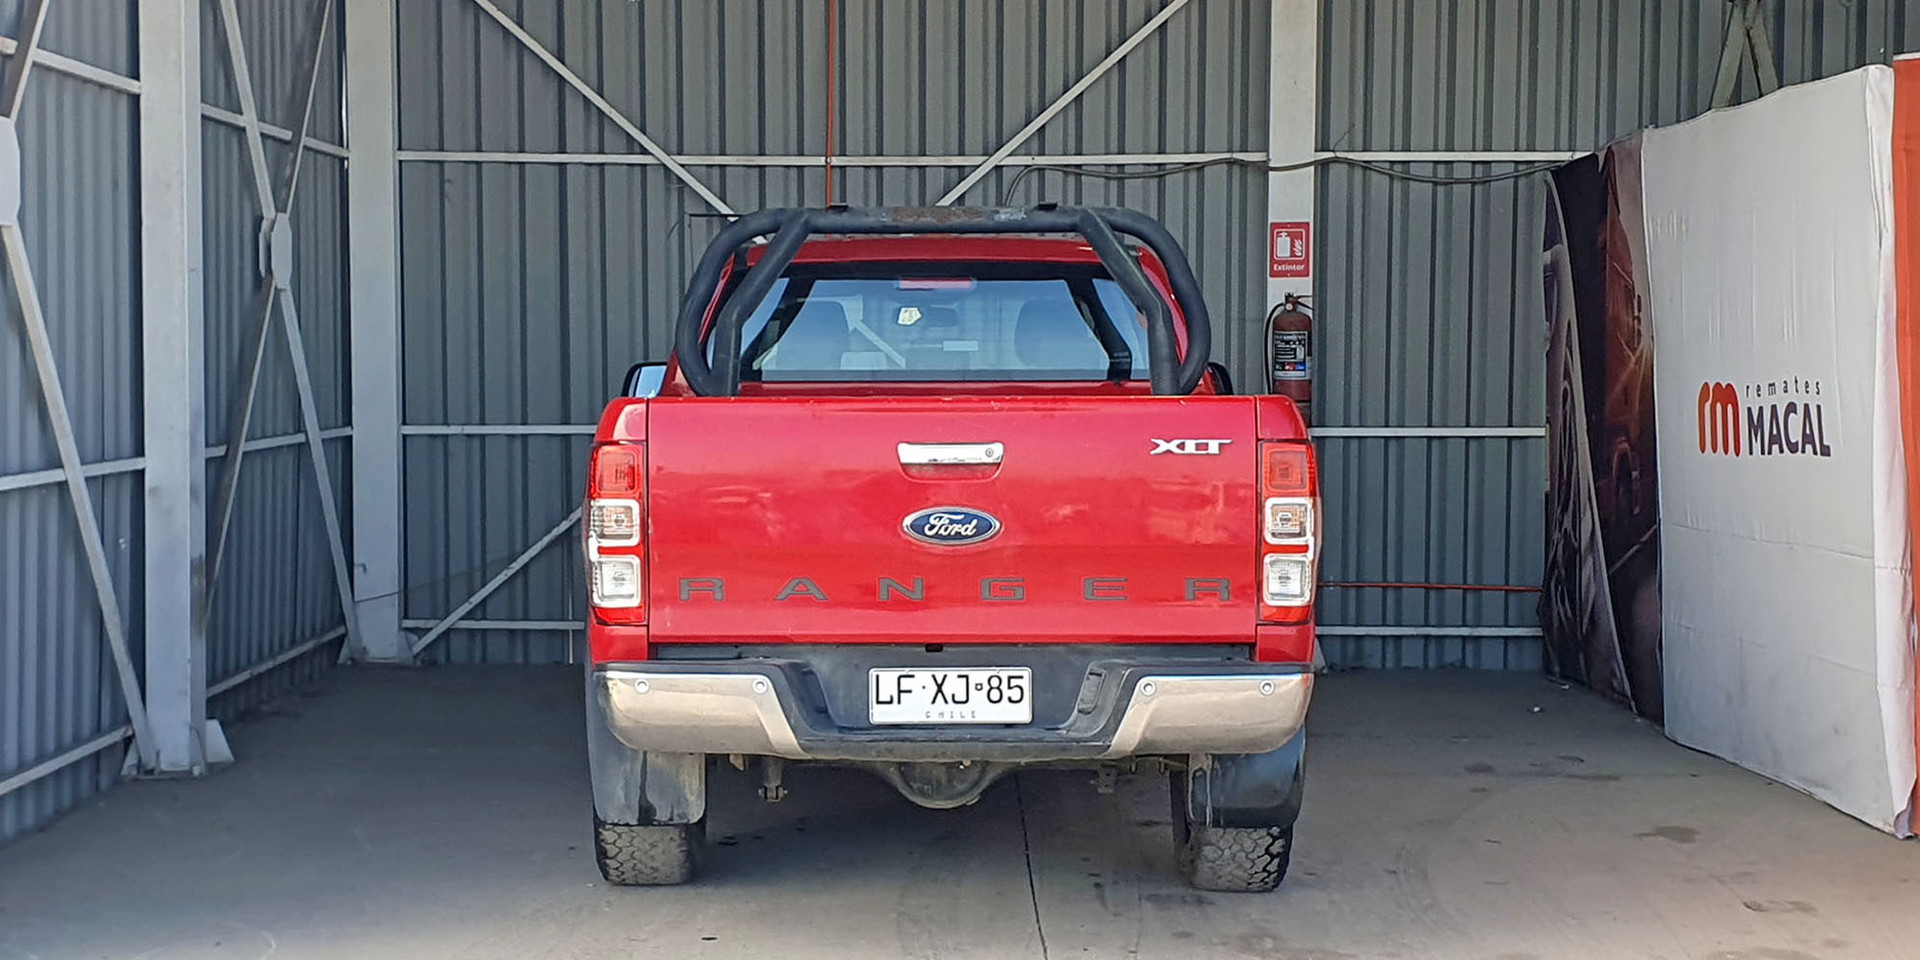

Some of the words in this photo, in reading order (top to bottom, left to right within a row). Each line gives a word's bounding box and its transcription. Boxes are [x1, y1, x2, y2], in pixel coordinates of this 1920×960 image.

[1273, 263, 1305, 271] Extintor
[1746, 376, 1821, 398] remates
[1746, 401, 1832, 457] MACAL
[1149, 438, 1233, 456] XLT
[924, 513, 978, 536] Ford
[678, 577, 1231, 601] RANGER
[925, 710, 976, 719] CHILE
